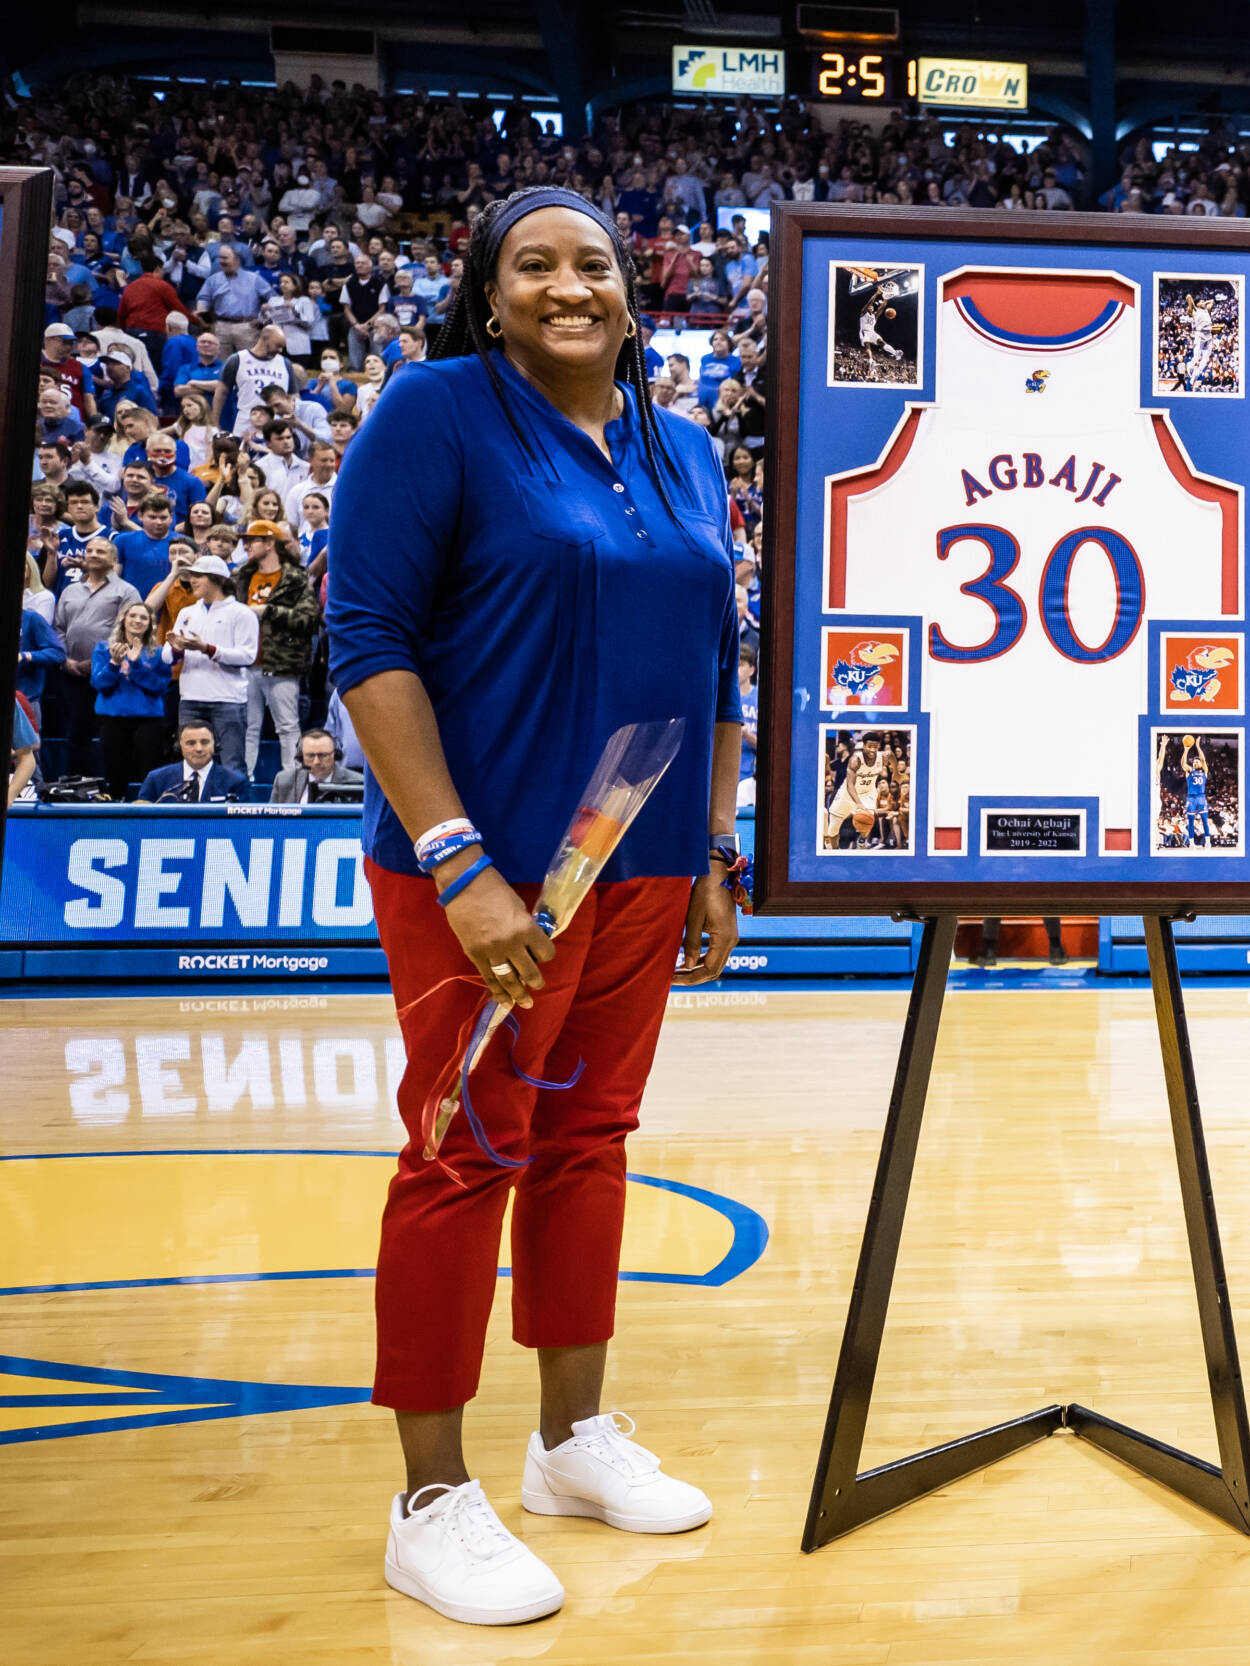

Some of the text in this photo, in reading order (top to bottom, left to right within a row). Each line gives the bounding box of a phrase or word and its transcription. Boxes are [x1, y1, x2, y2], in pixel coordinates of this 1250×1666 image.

[722, 52, 778, 73] LMH
[722, 74, 779, 90] Health
[961, 453, 1122, 507] AGBAJI
[929, 523, 1146, 664] 30
[848, 670, 866, 683] KU
[1185, 674, 1203, 687] KU
[1192, 776, 1203, 785] 30
[997, 817, 1072, 829] Ochai Agbaji
[178, 954, 329, 972] ROCKET Mortgage
